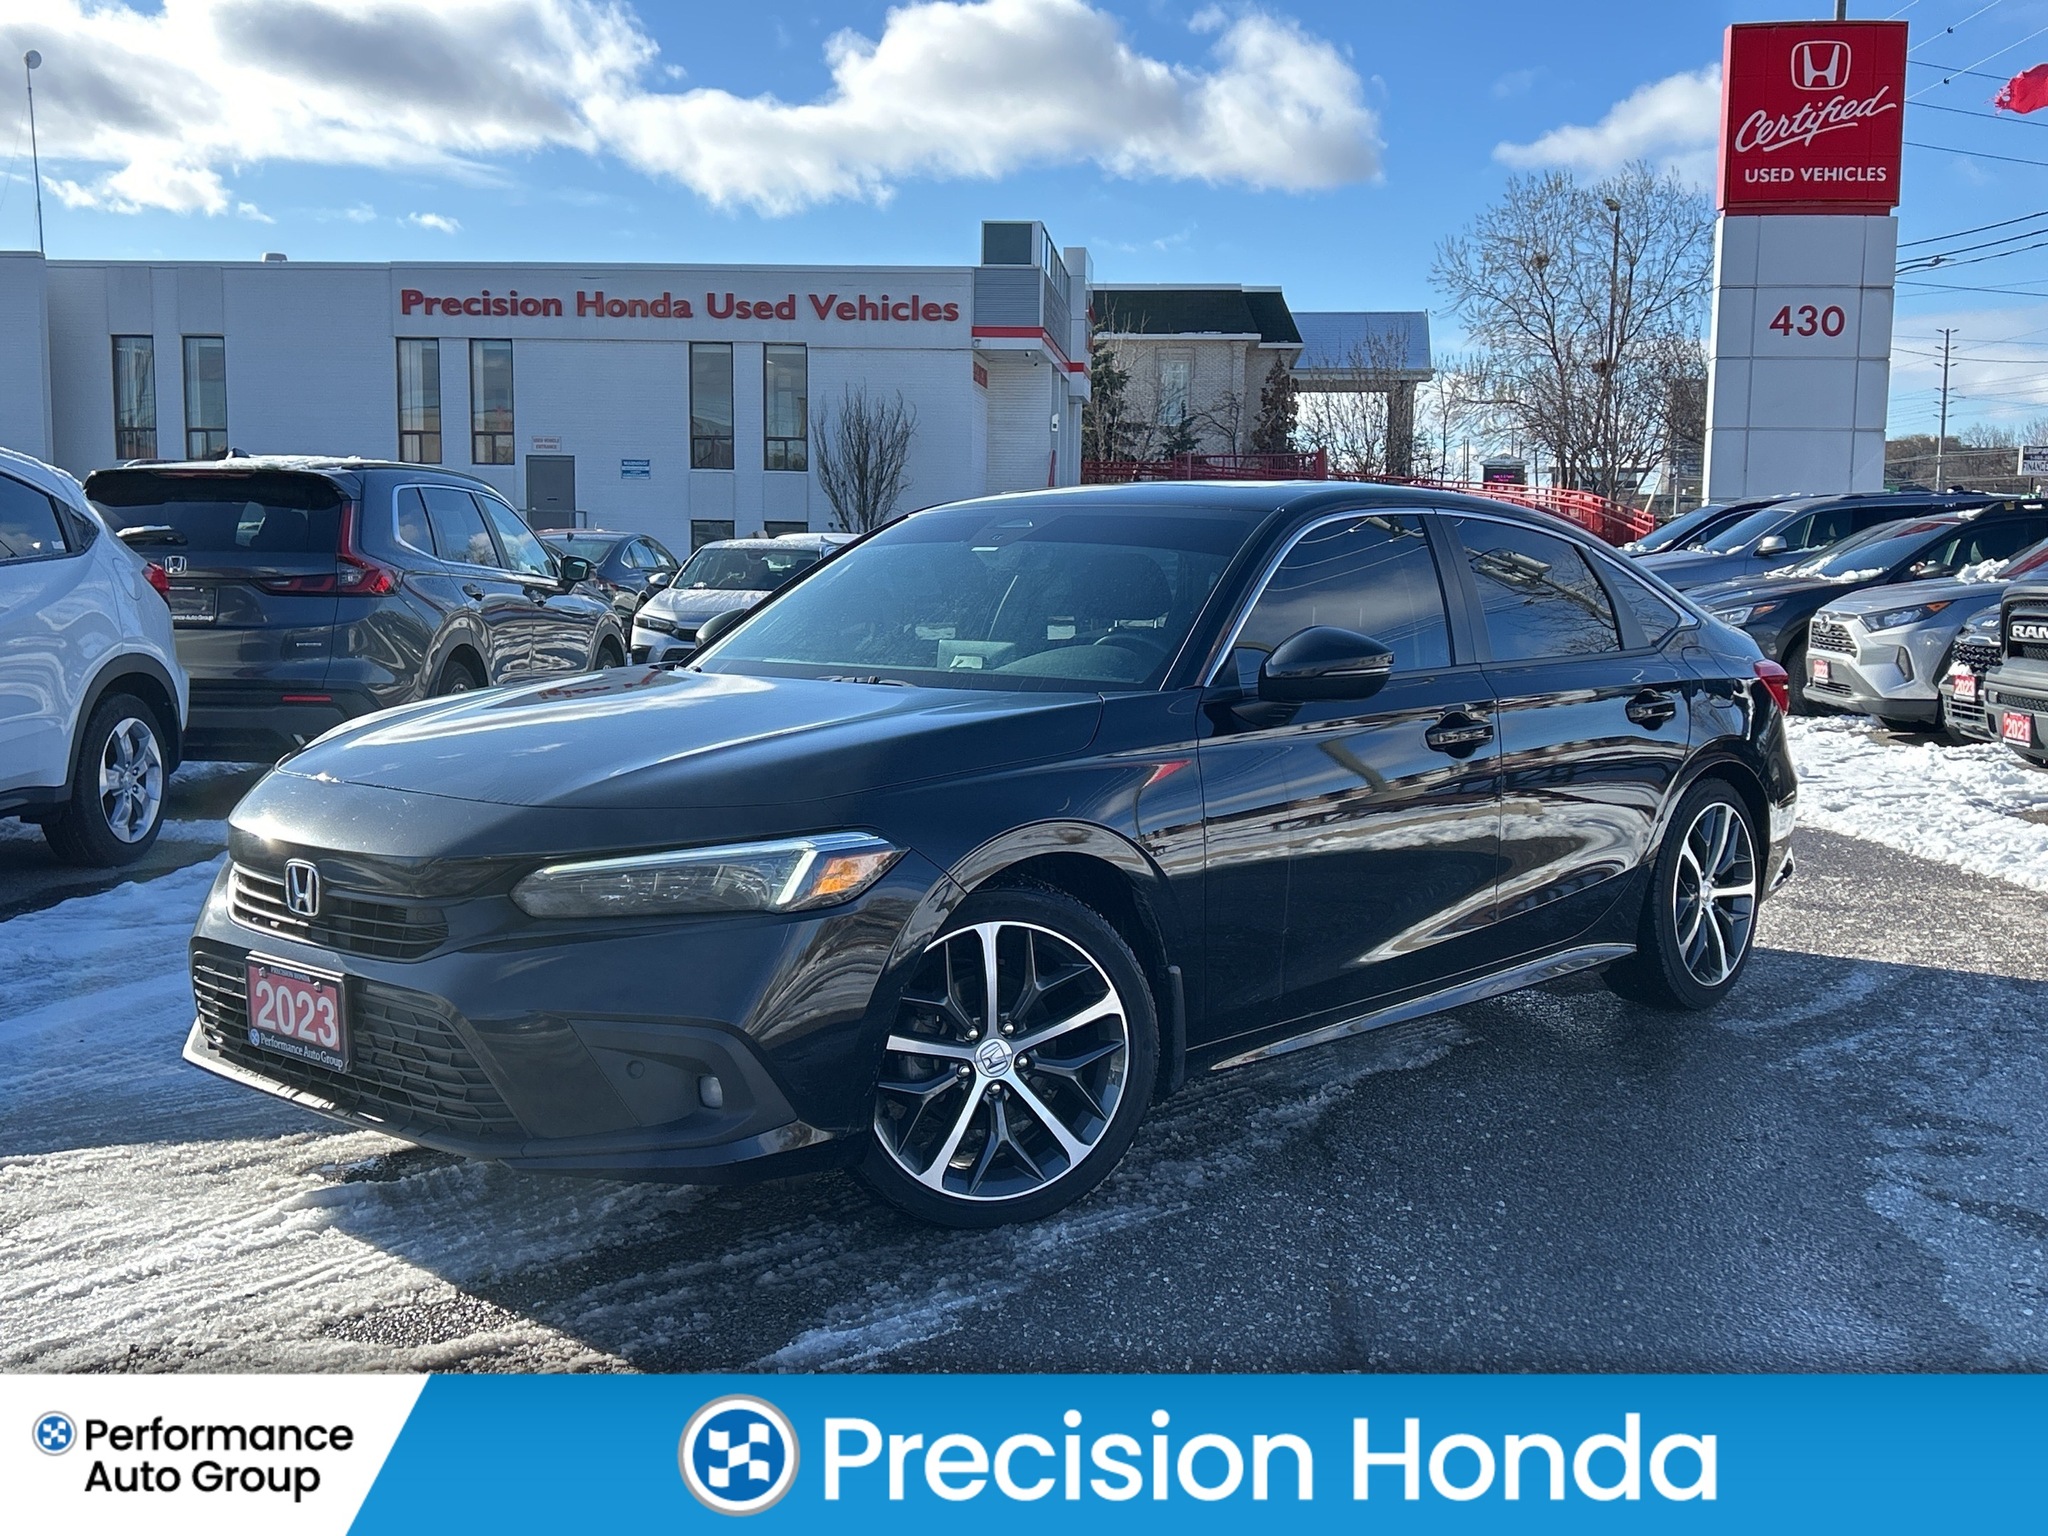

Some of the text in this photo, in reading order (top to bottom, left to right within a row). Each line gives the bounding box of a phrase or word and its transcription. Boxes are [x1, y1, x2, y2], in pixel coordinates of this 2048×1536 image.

[1735, 85, 1897, 152] Certified
[1745, 166, 1887, 183] USED VEHICLES
[401, 289, 959, 322] Precision Honda Used Vehicles
[1769, 305, 1845, 337] 430
[2012, 625, 2048, 639] RAM
[1955, 679, 1976, 695] 2023
[2005, 719, 2031, 741] 2021
[255, 980, 337, 1048] 2023
[260, 1032, 344, 1071] Performance Auto Group
